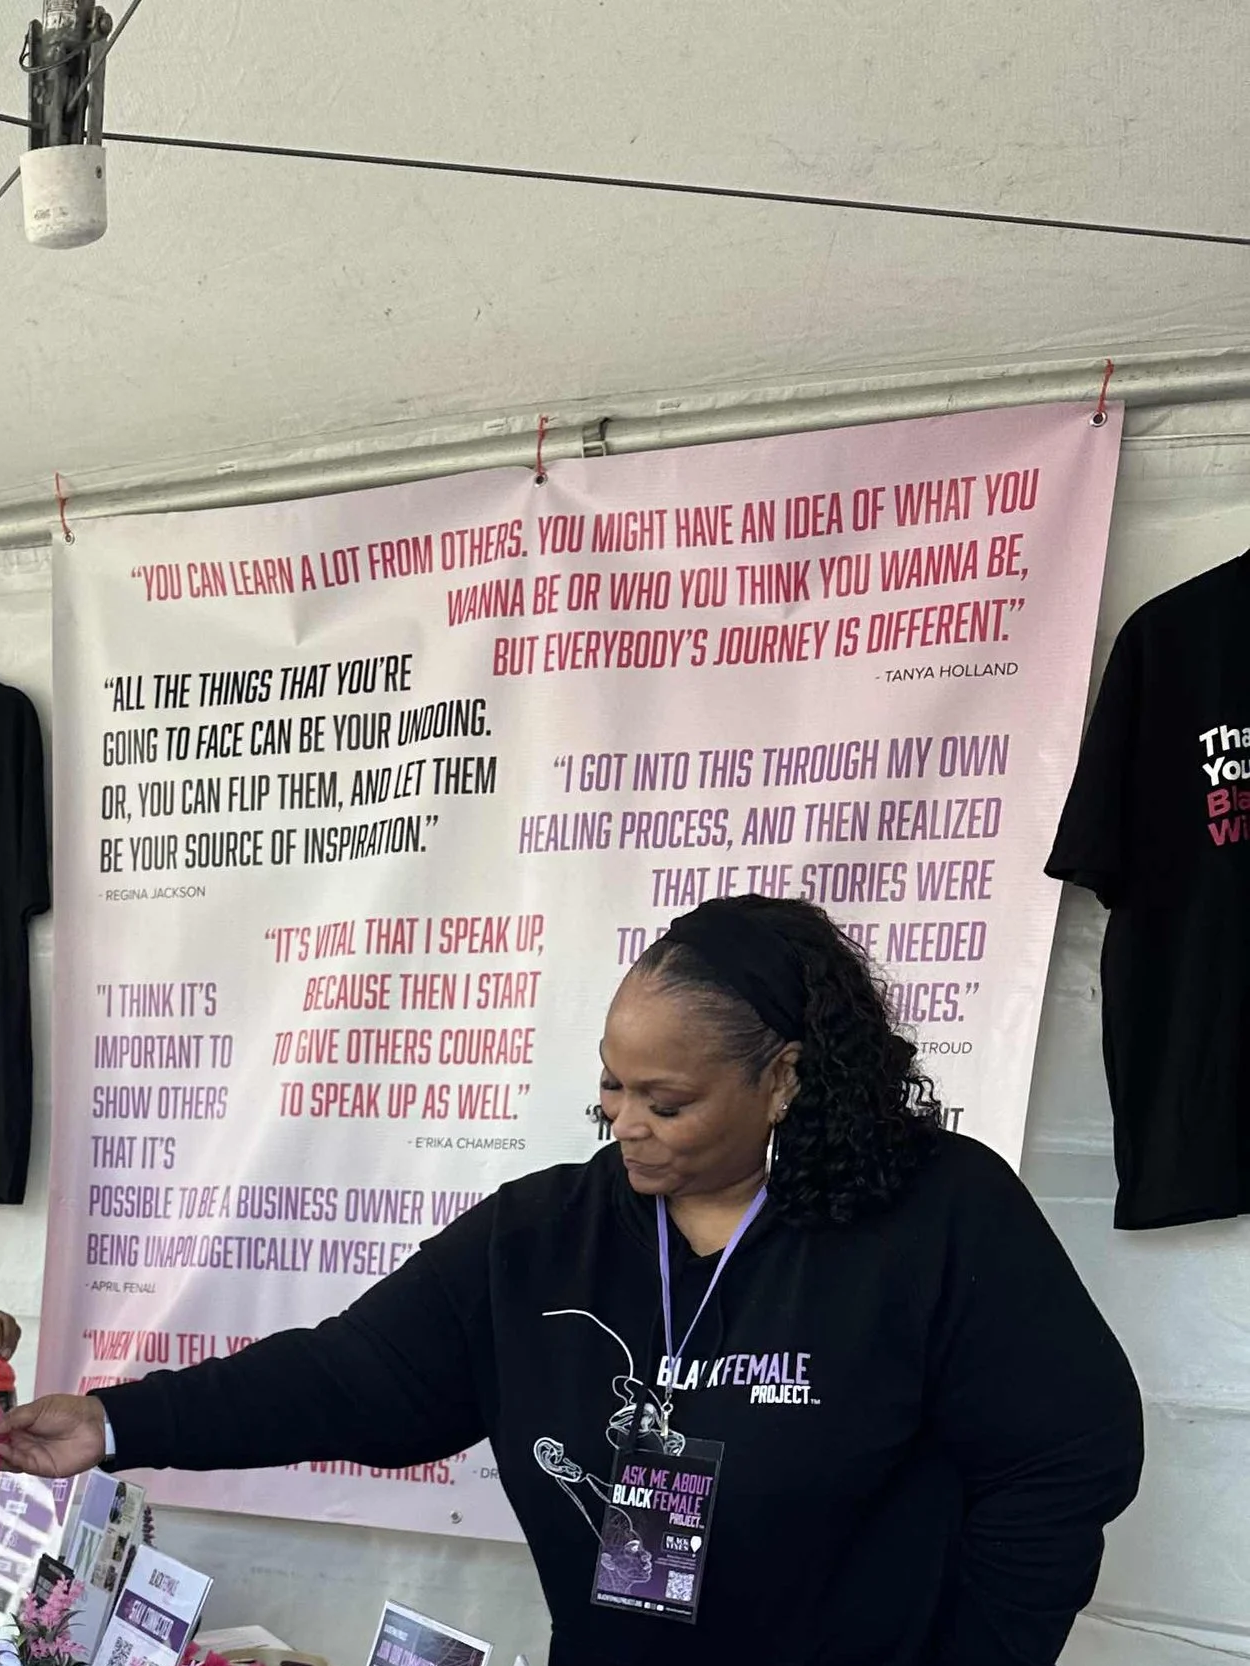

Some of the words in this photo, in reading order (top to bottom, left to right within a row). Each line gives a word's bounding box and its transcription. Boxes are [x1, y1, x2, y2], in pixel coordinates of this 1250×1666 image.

[187, 562, 227, 598] CAN
[229, 557, 294, 595] LEARN
[302, 555, 316, 591] A
[321, 547, 359, 587] LOT
[368, 535, 432, 580] FROM
[441, 520, 527, 570] OTHERS.
[539, 515, 584, 554] YOU
[592, 510, 667, 552] MIGHT
[676, 505, 733, 547] HAVE
[741, 500, 775, 543] AN
[786, 493, 843, 540] IDEA
[853, 487, 885, 531] OF
[894, 477, 976, 526] WHAT
[986, 468, 1039, 516] YOU
[448, 578, 524, 626] WANNA
[533, 574, 561, 615] BE
[567, 573, 601, 611] OR
[611, 571, 671, 610] WHO
[681, 567, 727, 608] YOU
[736, 560, 810, 605] THINK
[819, 554, 870, 598] YOU
[881, 540, 977, 591] WANNA
[987, 534, 1028, 581] BE,
[493, 636, 539, 676] BUT
[713, 620, 830, 665] JOURNEY
[835, 617, 860, 657] IS
[154, 674, 191, 708] THE
[199, 670, 272, 707] THINGS
[280, 664, 331, 700] THAT
[886, 667, 934, 682] TANYA
[940, 663, 1018, 677] HOLLAND
[104, 728, 158, 766] GOING
[166, 727, 190, 761] TO
[196, 722, 244, 759] FACE
[251, 719, 292, 755] CAN
[300, 716, 325, 753] BE
[333, 713, 391, 751] YOUR
[398, 699, 491, 746] UNDOING.
[580, 754, 627, 791] GOT
[633, 752, 689, 791] INTO
[699, 749, 753, 788] THIS
[763, 740, 879, 786] THROUGH
[887, 737, 933, 778] MY
[939, 734, 1009, 777] OWN
[102, 785, 131, 822] OR,
[139, 781, 174, 817] YOU
[182, 778, 220, 814] CAN
[229, 775, 270, 812] FLIP
[278, 772, 343, 812] THEM,
[351, 768, 391, 806] AND
[394, 760, 426, 799] LET
[433, 757, 496, 794] THEM
[519, 812, 612, 853] HEALING
[619, 809, 733, 851] PROCESS,
[742, 806, 795, 845] AND
[805, 802, 870, 842] THEN
[878, 798, 1002, 841] REALIZED
[101, 839, 123, 872] BE
[130, 835, 177, 871] YOUR
[185, 831, 263, 868] SOURCE
[271, 829, 296, 865] OF
[106, 889, 148, 901] REGINA
[151, 886, 205, 899] JACKSON
[652, 867, 710, 907] THAT
[715, 867, 739, 899] IF
[748, 864, 793, 899] THE
[800, 861, 907, 902] STORIES
[918, 860, 995, 901] WERE
[315, 920, 355, 959] VITAL
[366, 918, 419, 954] THAT
[425, 918, 432, 954] I
[439, 916, 510, 953] SPEAK
[516, 914, 544, 955] UP,
[617, 927, 645, 965] TO
[887, 921, 986, 961] NEEDED
[119, 983, 174, 1017] THINK
[303, 974, 392, 1011] BECAUSE
[400, 974, 456, 1009] THEN
[463, 974, 470, 1009] I
[477, 971, 541, 1009] START
[889, 982, 979, 1023] OICES.”
[95, 1035, 204, 1068] IMPORTANT
[210, 1035, 233, 1068] TO
[273, 1032, 293, 1065] TO
[296, 1029, 339, 1063] GIVE
[347, 1029, 432, 1064] OTHERS
[439, 1028, 535, 1064] COURAGE
[921, 1042, 972, 1054] TROUD
[93, 1086, 152, 1119] SHOW
[158, 1086, 228, 1119] OTHERS
[281, 1083, 303, 1116] TO
[311, 1083, 381, 1118] SPEAK
[388, 1084, 416, 1118] UP
[422, 1084, 450, 1119] AS
[91, 1135, 137, 1170] THAT
[456, 1137, 525, 1150] CHAMBERS
[89, 1185, 173, 1218] POSSIBLE
[179, 1187, 198, 1219] TO
[198, 1186, 219, 1218] BE
[219, 1186, 230, 1219] A
[237, 1186, 338, 1221] BUSINESS
[345, 1189, 424, 1224] OWNER
[87, 1233, 139, 1267] BEING
[145, 1236, 313, 1271] UNAPOLOGETICALLY
[91, 1281, 121, 1292] APRIL
[136, 1332, 169, 1362] YOU
[175, 1333, 219, 1366] TELL
[656, 1352, 811, 1390] BLAKFEMALE
[621, 1465, 647, 1486] ASK
[649, 1468, 670, 1489] ME
[671, 1472, 713, 1496] ABOUT
